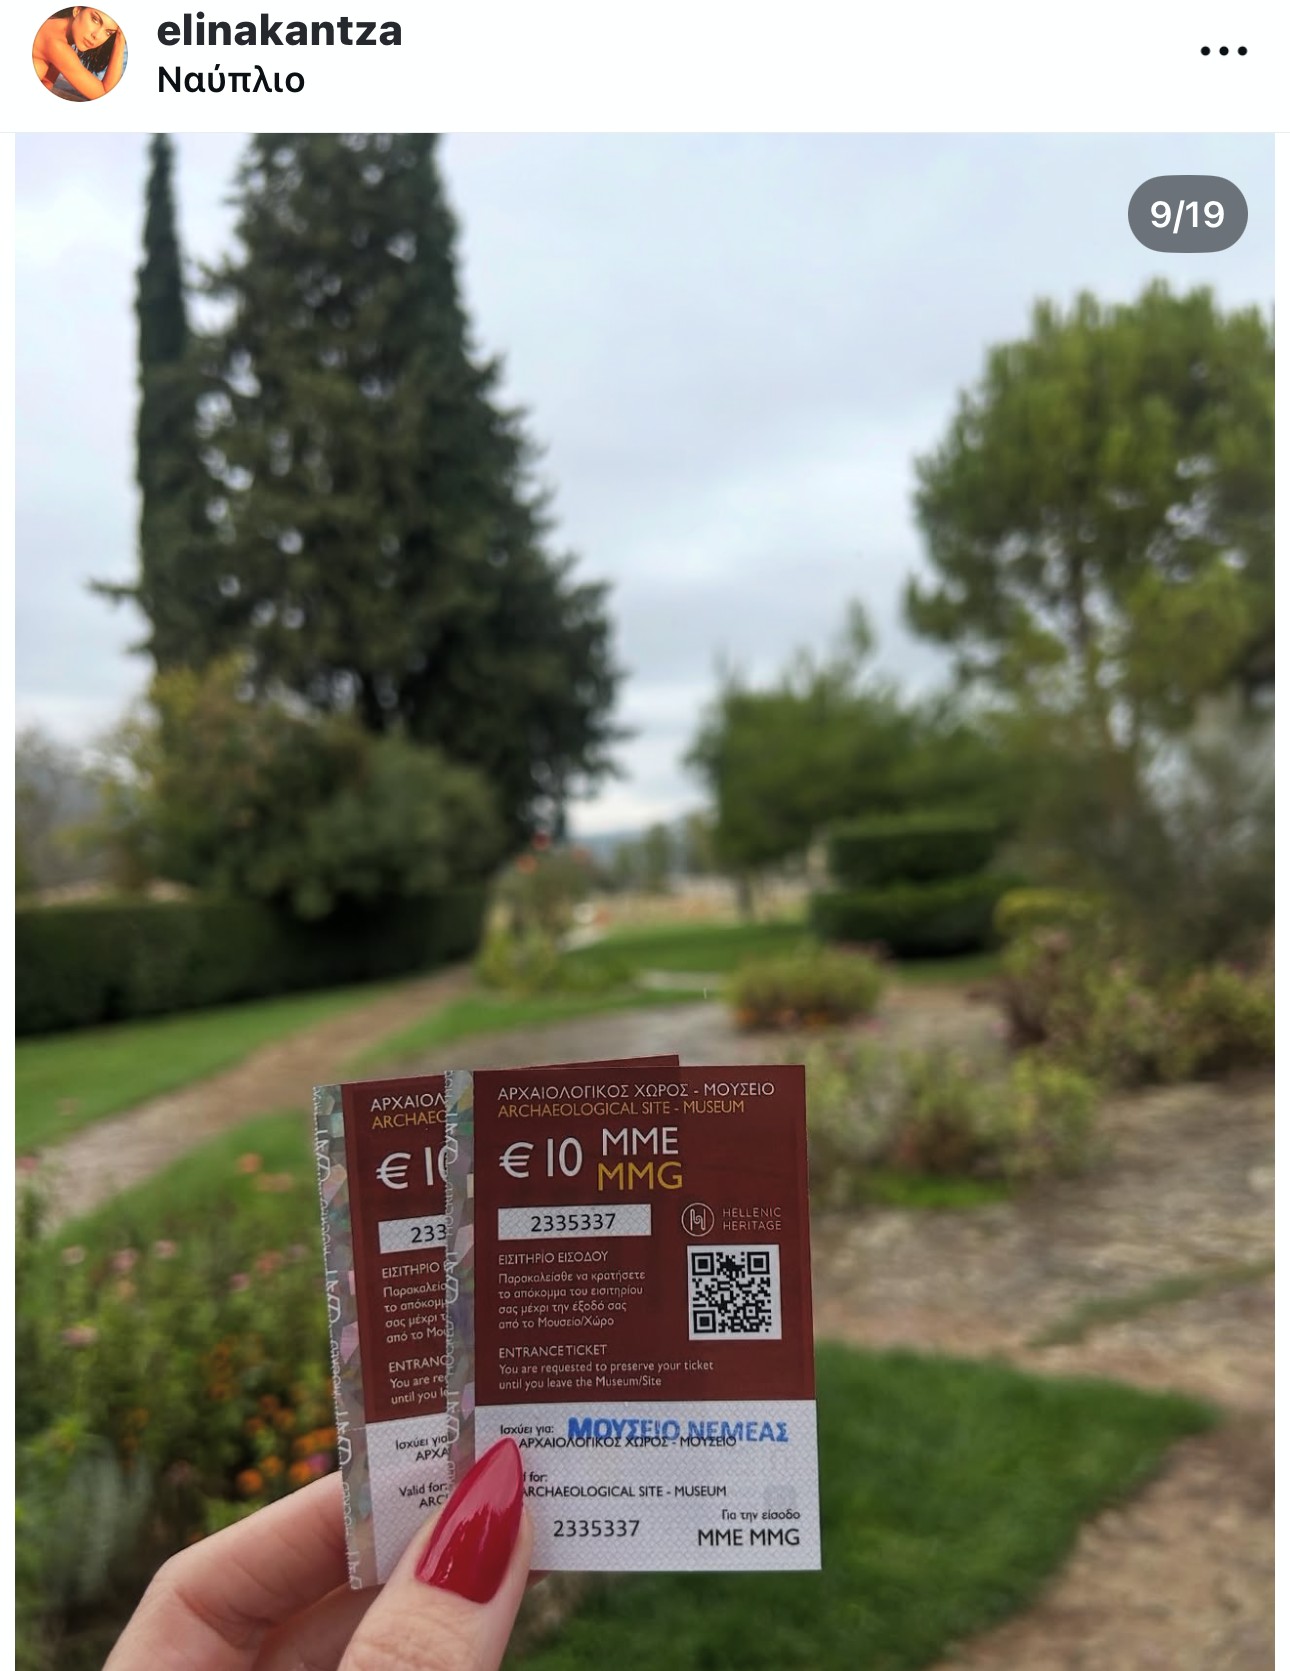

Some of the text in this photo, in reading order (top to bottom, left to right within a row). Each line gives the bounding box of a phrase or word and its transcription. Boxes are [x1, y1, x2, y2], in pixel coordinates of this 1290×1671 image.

[498, 1084, 629, 1100] ΑΡΧΑΙΟΛΟΓΙΚΟΣ
[634, 1083, 689, 1098] ΧΩΡΟΣ
[704, 1082, 775, 1097] ΜΟΥΣΕΙΟ
[498, 1102, 638, 1118] ARCHAEOLOGICAL
[642, 1101, 670, 1115] SITE
[683, 1100, 745, 1114] MUSEUM
[547, 1137, 583, 1177] 10
[598, 1161, 683, 1191] MMG
[723, 1207, 782, 1218] HELLENIC
[531, 1213, 616, 1232] 2335337
[723, 1220, 782, 1231] HERITAGE
[498, 1250, 609, 1265] ΕΙΣΙΤΗΡΙΟ ΕΙΣΟΔΟΥ
[576, 1273, 588, 1282] να
[498, 1290, 511, 1299] το
[569, 1287, 588, 1297] του
[384, 1304, 397, 1313] το
[498, 1305, 518, 1317] σας
[551, 1303, 569, 1314] την
[607, 1302, 627, 1313] σας
[385, 1318, 406, 1328] σας
[498, 1317, 519, 1330] από
[522, 1320, 535, 1329] το
[386, 1331, 407, 1343] από
[411, 1332, 423, 1340] το
[499, 1344, 608, 1359] ENTRANCE TICKET
[499, 1359, 714, 1375] You are requested to preserve your ticket
[390, 1377, 410, 1389] You
[413, 1376, 430, 1387] are
[499, 1374, 662, 1391] until you leave the Museum/Site
[391, 1391, 415, 1405] until
[417, 1390, 437, 1404] you
[567, 1417, 680, 1442] ΜΟΥΣΕΙΟ
[625, 1436, 669, 1448] ΧΩΡΟΣ
[529, 1471, 548, 1483] for:
[399, 1481, 448, 1497] Valid for:
[639, 1485, 663, 1497] SITE
[674, 1485, 727, 1497] MUSEUM
[740, 1510, 758, 1523] την
[553, 1519, 640, 1537] 2335337
[750, 1528, 801, 1546] MMG
